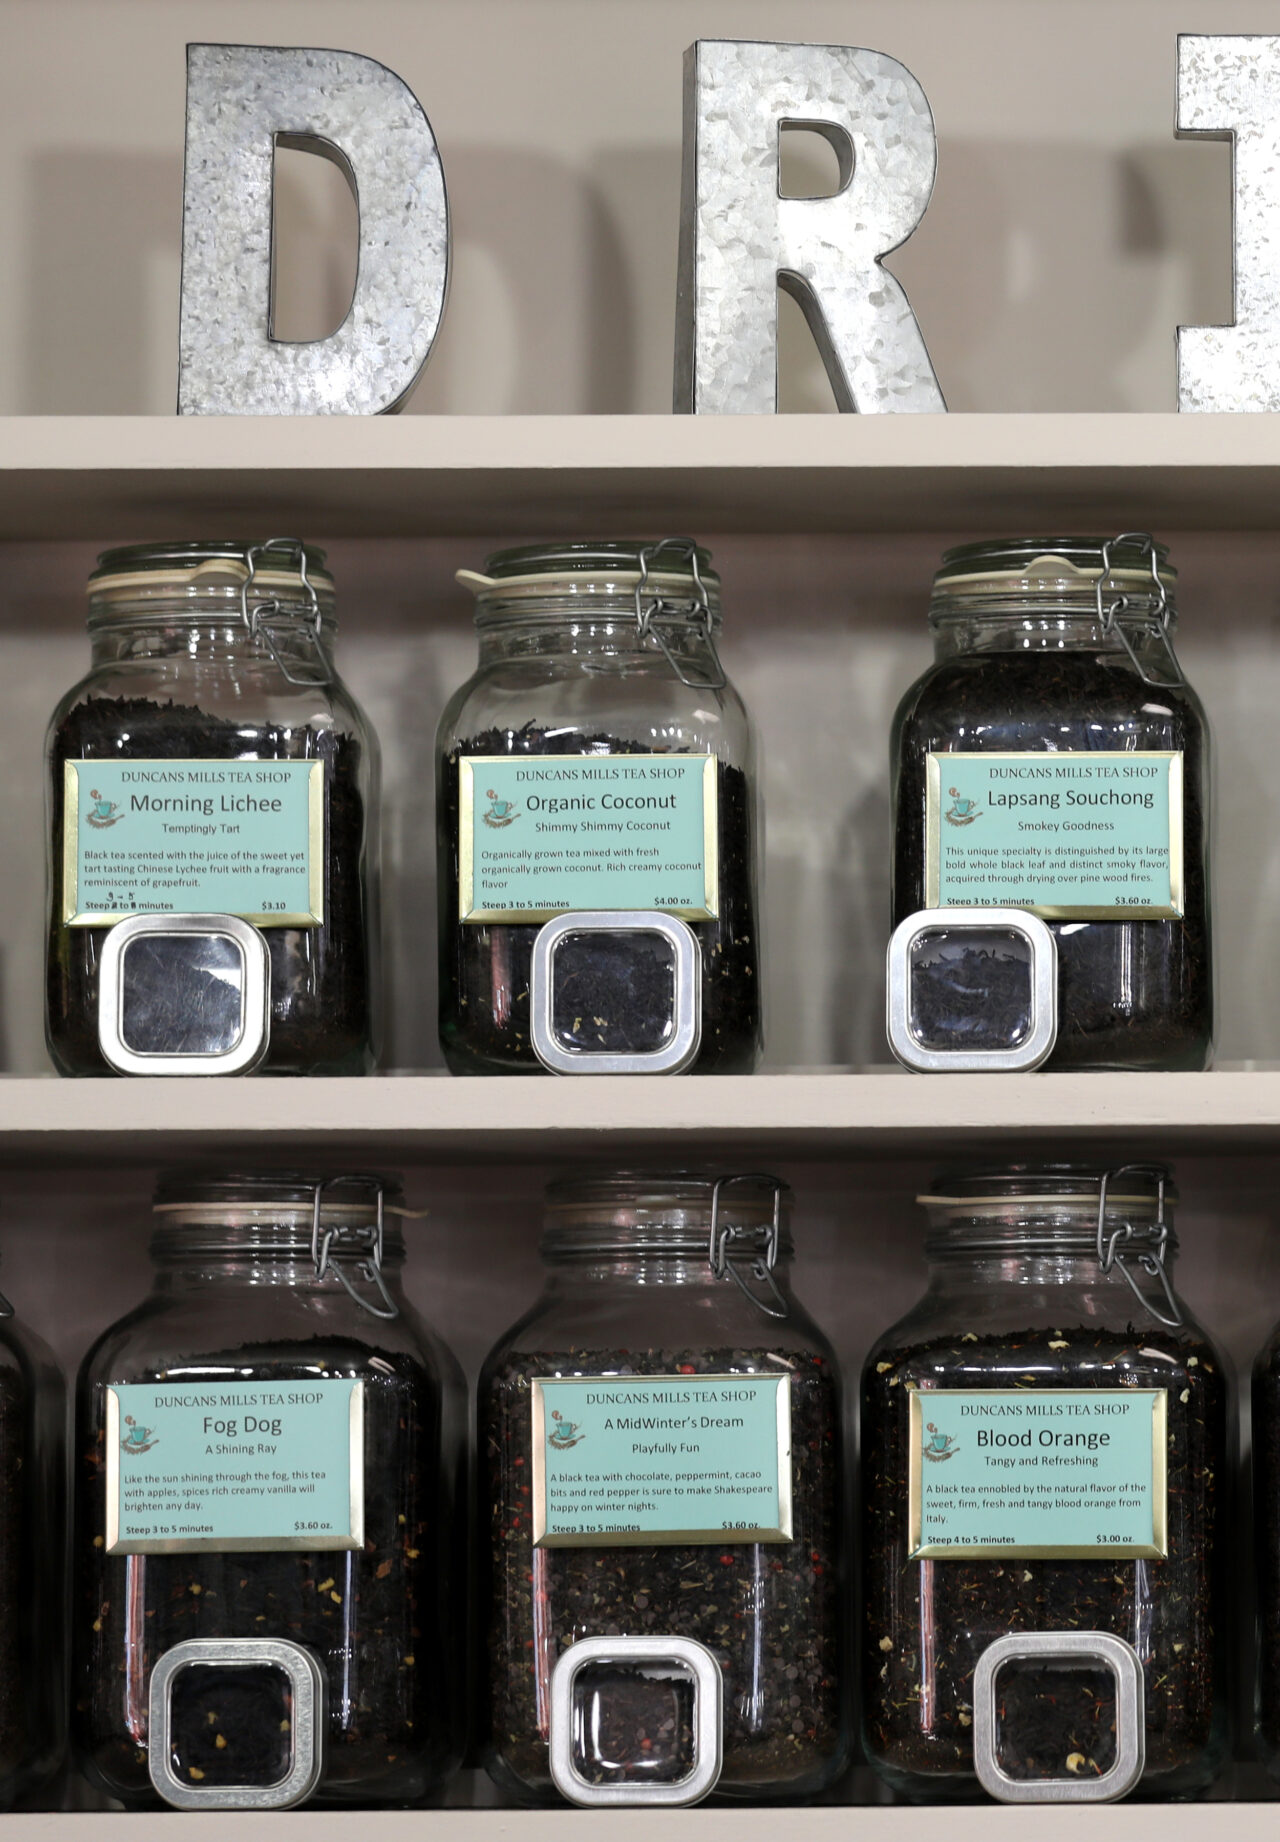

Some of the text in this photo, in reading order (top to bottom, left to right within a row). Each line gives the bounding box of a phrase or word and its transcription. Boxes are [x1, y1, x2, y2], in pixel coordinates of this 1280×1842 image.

[121, 771, 291, 783] DUNCANS MILLS TEA SHOP
[516, 768, 685, 781] DUNCANS MILLS TEA SHOP
[990, 767, 1158, 778] DUNCANS MILLS TEA SHOP
[131, 794, 282, 816] Morning Lichee
[526, 794, 676, 813] Organic Coconut
[989, 789, 1154, 810] Lapsang Souchong
[162, 823, 240, 836] Temptingly Tart
[535, 820, 670, 834] Shimmy Shimmy Coconut
[1018, 820, 1114, 833] Smokey Goodness
[84, 850, 304, 862] Black tea scented with the juice of the sweet yet
[946, 846, 964, 855] This
[967, 848, 999, 857] unique
[1002, 846, 1042, 857] specialty
[1054, 846, 1115, 857] distinguished
[1118, 846, 1129, 856] by
[1132, 846, 1143, 855] its
[1146, 845, 1169, 856] large
[654, 897, 679, 906] $4.00
[155, 1393, 323, 1408] DUNCANS MILLS TEA SHOP
[587, 1390, 756, 1404] DUNCANS MILLS TEA SHOP
[961, 1404, 1130, 1416] DUNCANS MILLS TEA SHOP
[204, 1416, 282, 1437] Fog Dog
[604, 1418, 614, 1430] A
[700, 1416, 744, 1428] Dream
[977, 1429, 1110, 1450] Blood Orange
[205, 1443, 277, 1456] A Shining Ray
[632, 1443, 700, 1455] Playfully Fun
[985, 1455, 1098, 1468] Tangy and Refreshing
[550, 1474, 557, 1482] A
[559, 1473, 583, 1482] black
[585, 1474, 600, 1482] tea
[602, 1472, 623, 1482] with
[625, 1472, 673, 1481] chocolate,
[675, 1471, 732, 1482] peppermint,
[294, 1521, 319, 1531] $3.60
[928, 1536, 1017, 1546] Steep 4 to 5 minutes
[1096, 1534, 1121, 1544] $3.00
